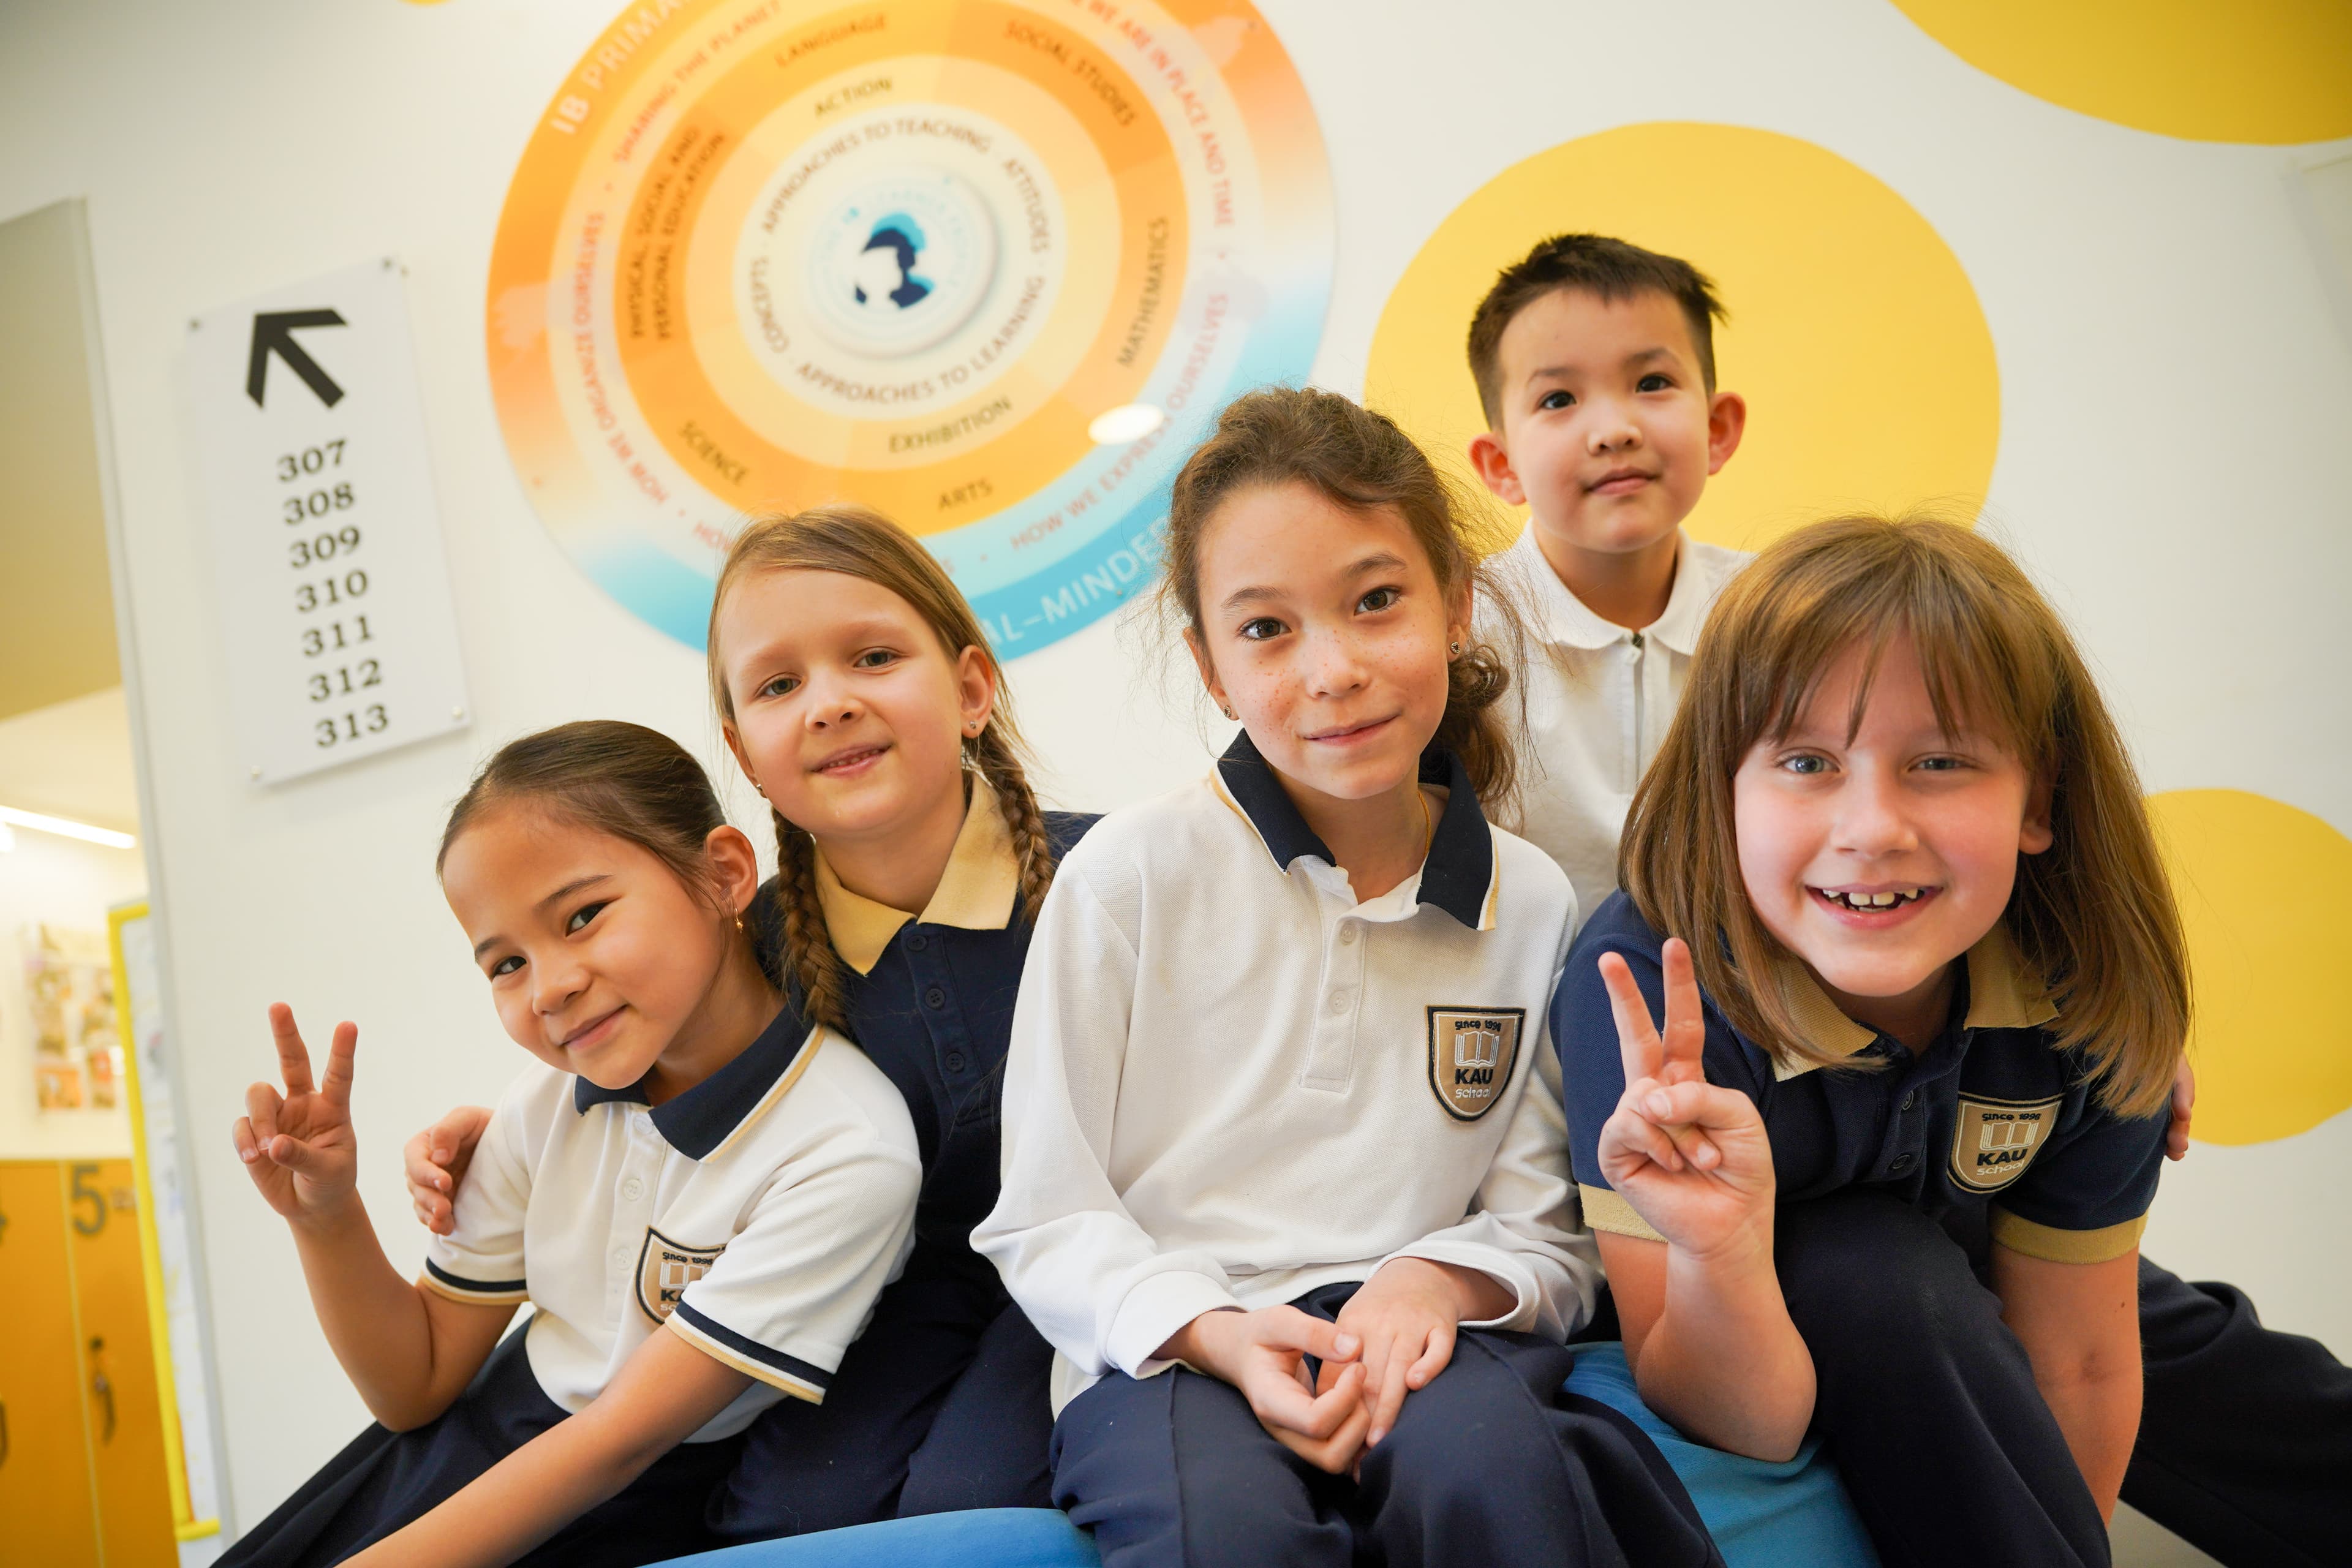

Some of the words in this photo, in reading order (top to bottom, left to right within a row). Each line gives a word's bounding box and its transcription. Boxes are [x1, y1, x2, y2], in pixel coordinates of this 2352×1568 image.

[774, 13, 886, 69] LANGUAGE
[1003, 20, 1071, 65] SOCIAL
[1073, 58, 1137, 127] STUDIES
[551, 95, 587, 135] IB
[612, 82, 676, 163] SHARING
[674, 49, 708, 81] THE
[814, 77, 892, 118] ACTION
[1118, 19, 1152, 50] ARE
[1166, 68, 1208, 126] PLACE
[1198, 132, 1226, 174] AND
[1212, 179, 1234, 228] TIME
[670, 127, 700, 167] AND
[660, 133, 724, 238] EDUCATION
[763, 132, 860, 233] APPROACHES
[862, 122, 891, 141] TO
[895, 119, 991, 154] TEACHING
[1003, 158, 1049, 254] ATTITUDES
[572, 212, 605, 326] OURSELVES
[1115, 215, 1169, 368] MATHEMATICS
[652, 243, 673, 342] PERSONAL
[750, 255, 790, 353] CONCEPTS
[797, 361, 936, 405] APPROACHES
[940, 364, 970, 388] TO
[970, 276, 1046, 371] LEARNING
[888, 398, 1012, 453] EXHIBITION
[1009, 511, 1065, 552] HOW
[1065, 487, 1099, 517] WE
[1165, 292, 1229, 410] OURSELVES
[277, 438, 349, 483] 307
[606, 430, 633, 461] WE
[678, 420, 748, 486] SCIENCE
[283, 482, 355, 526] 308
[629, 461, 669, 504] HOW
[938, 477, 993, 513] ARTS
[289, 526, 361, 569] 309
[296, 569, 369, 612] 310
[302, 614, 375, 657] 311
[309, 658, 383, 703] 312
[315, 703, 390, 748] 313
[1455, 1068, 1493, 1084] KAU
[1455, 1087, 1491, 1098] school
[1977, 1148, 2027, 1166] KAU
[1977, 1159, 2024, 1175] school
[72, 1163, 106, 1235] 5
